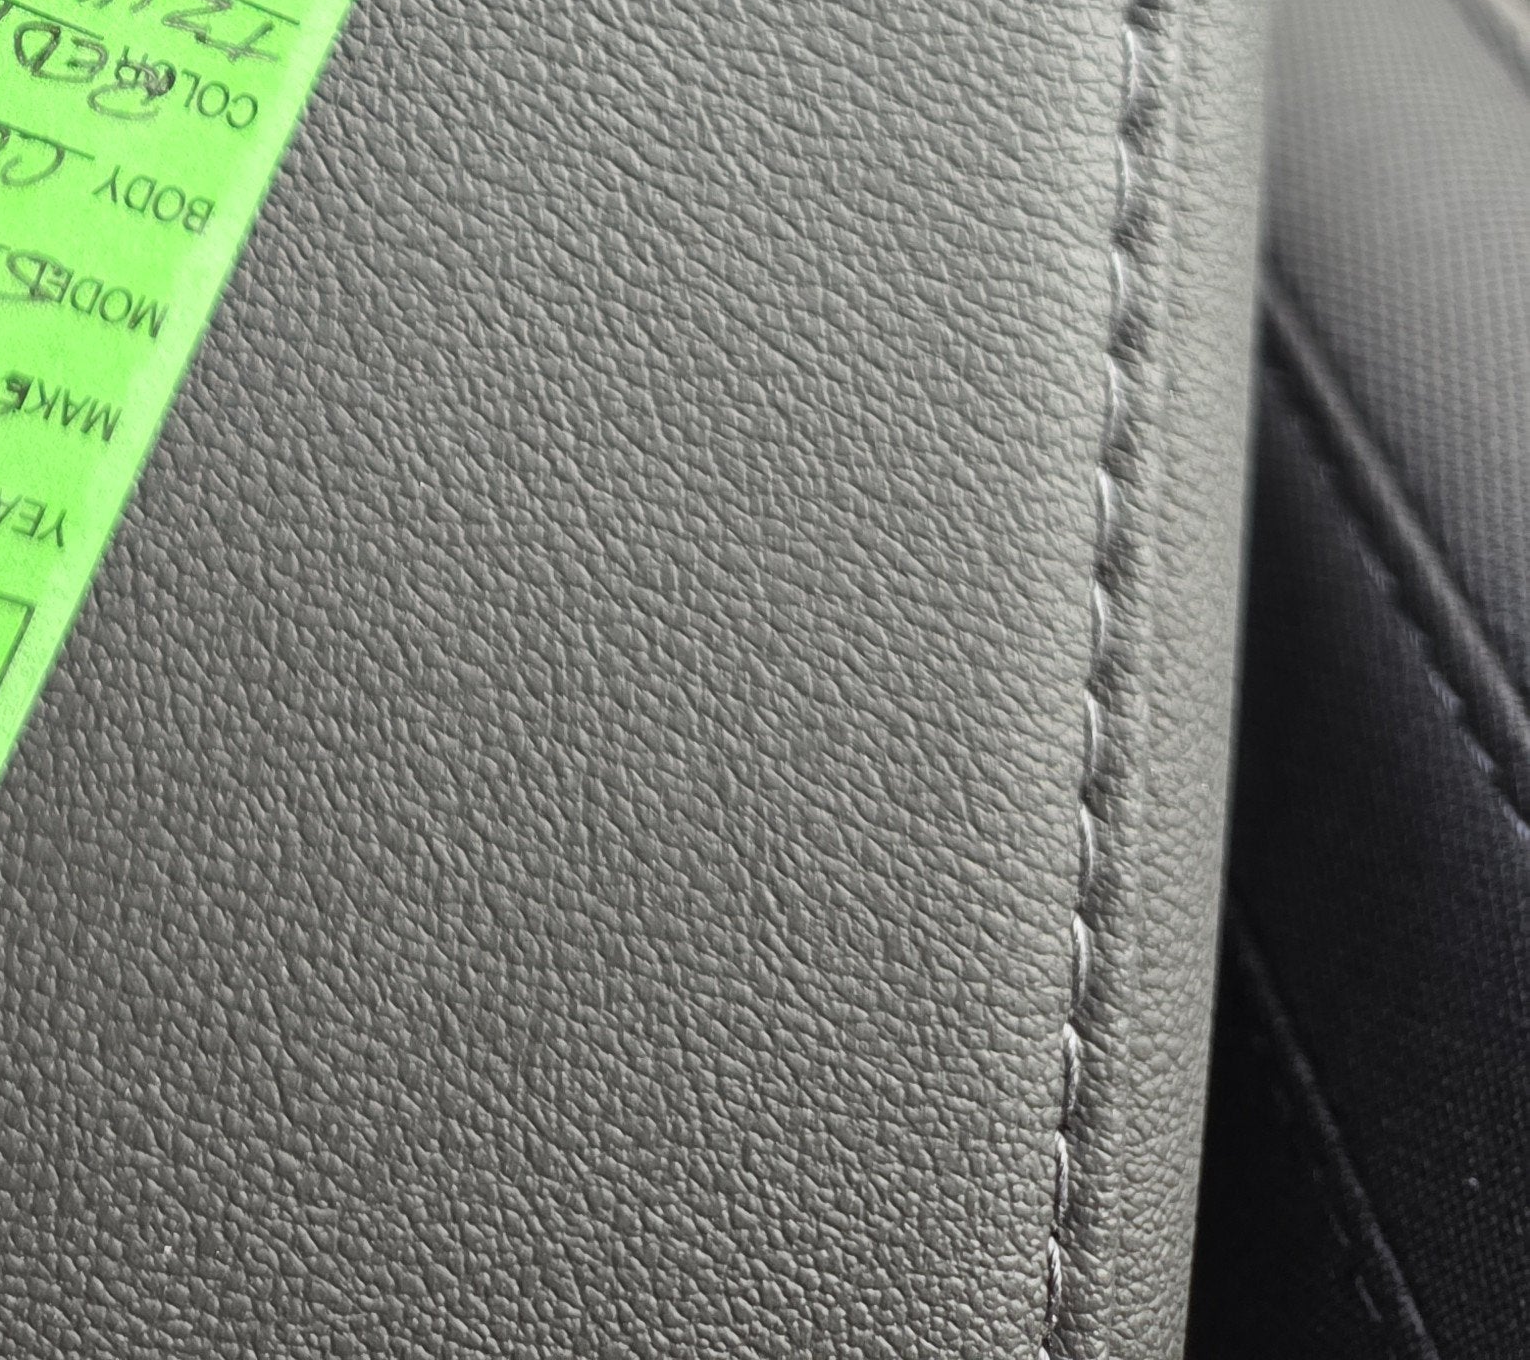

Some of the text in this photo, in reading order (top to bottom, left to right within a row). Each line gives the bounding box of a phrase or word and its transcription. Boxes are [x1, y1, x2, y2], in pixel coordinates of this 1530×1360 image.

[9, 24, 170, 112] RED
[112, 45, 261, 131] COLOR
[93, 165, 214, 233] BODY
